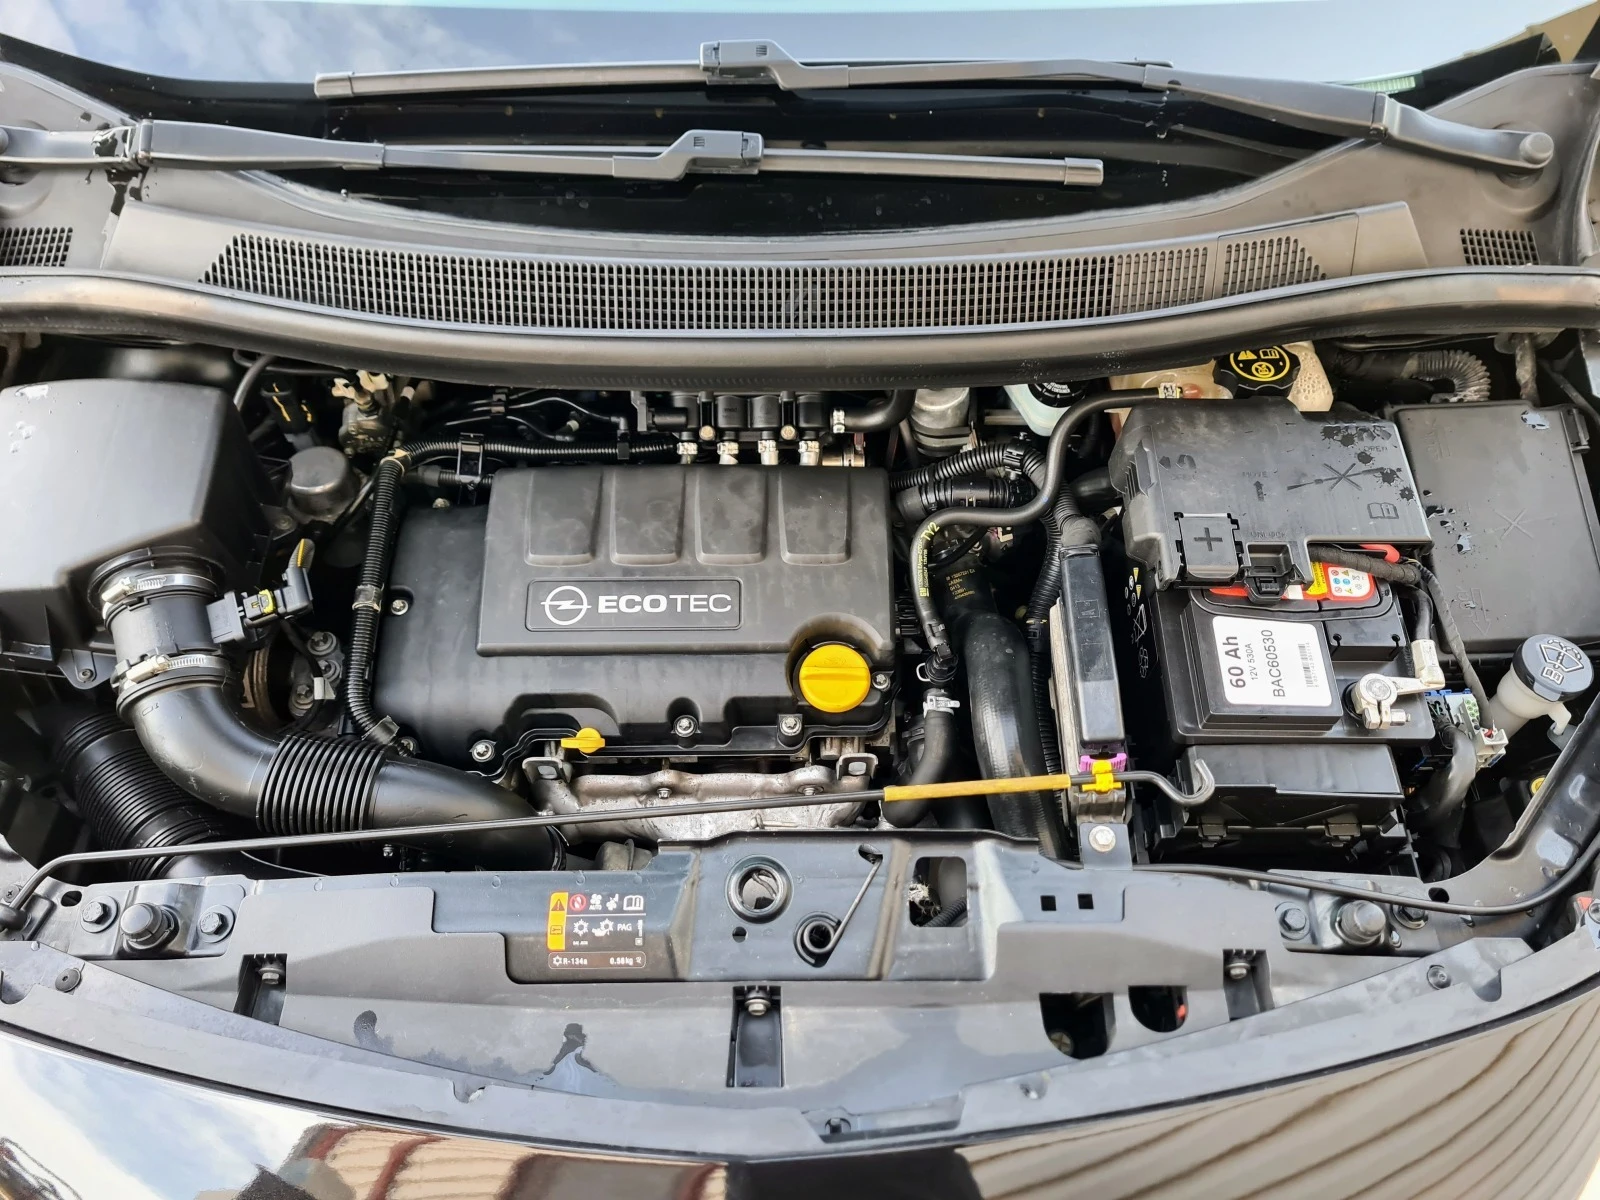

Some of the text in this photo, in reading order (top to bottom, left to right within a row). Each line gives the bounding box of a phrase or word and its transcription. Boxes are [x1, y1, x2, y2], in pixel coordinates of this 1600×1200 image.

[921, 522, 940, 540] TY2
[597, 593, 732, 613] ECOTEC
[1222, 636, 1246, 688] 60 Ah
[1245, 643, 1259, 681] 12V 530A
[1261, 629, 1286, 698] BAC60530
[617, 923, 632, 931] PAG
[563, 957, 587, 965] R-134a
